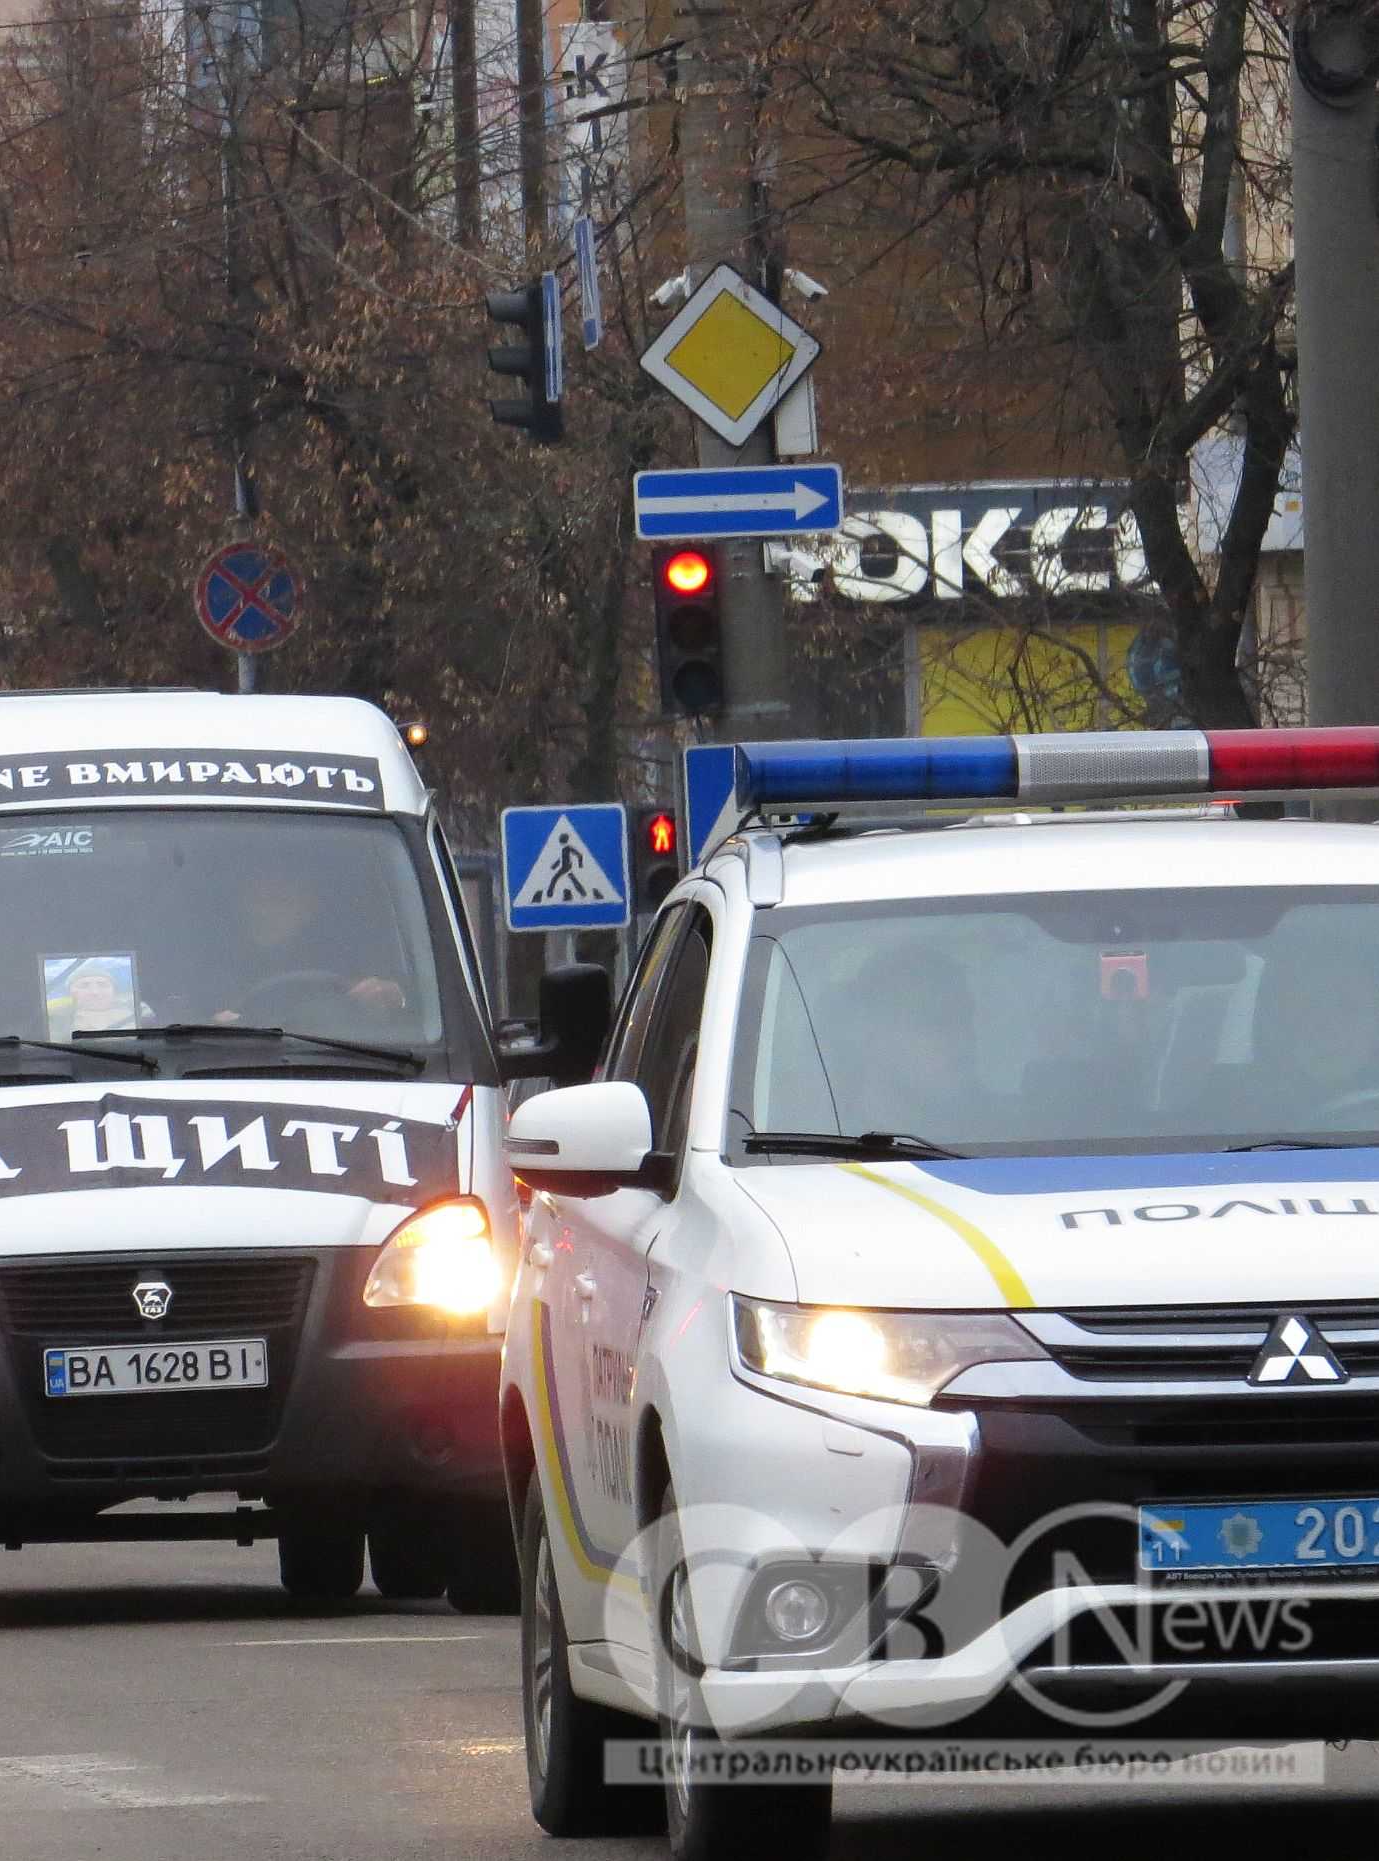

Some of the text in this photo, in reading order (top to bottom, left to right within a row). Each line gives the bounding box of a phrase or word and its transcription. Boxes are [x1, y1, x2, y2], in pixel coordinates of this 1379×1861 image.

[66, 761, 375, 793] ВМИРАЮТЬ
[68, 1355, 116, 1388] BA
[127, 1351, 199, 1384] 1628
[209, 1347, 249, 1381] BI
[1294, 1506, 1379, 1560] 20
